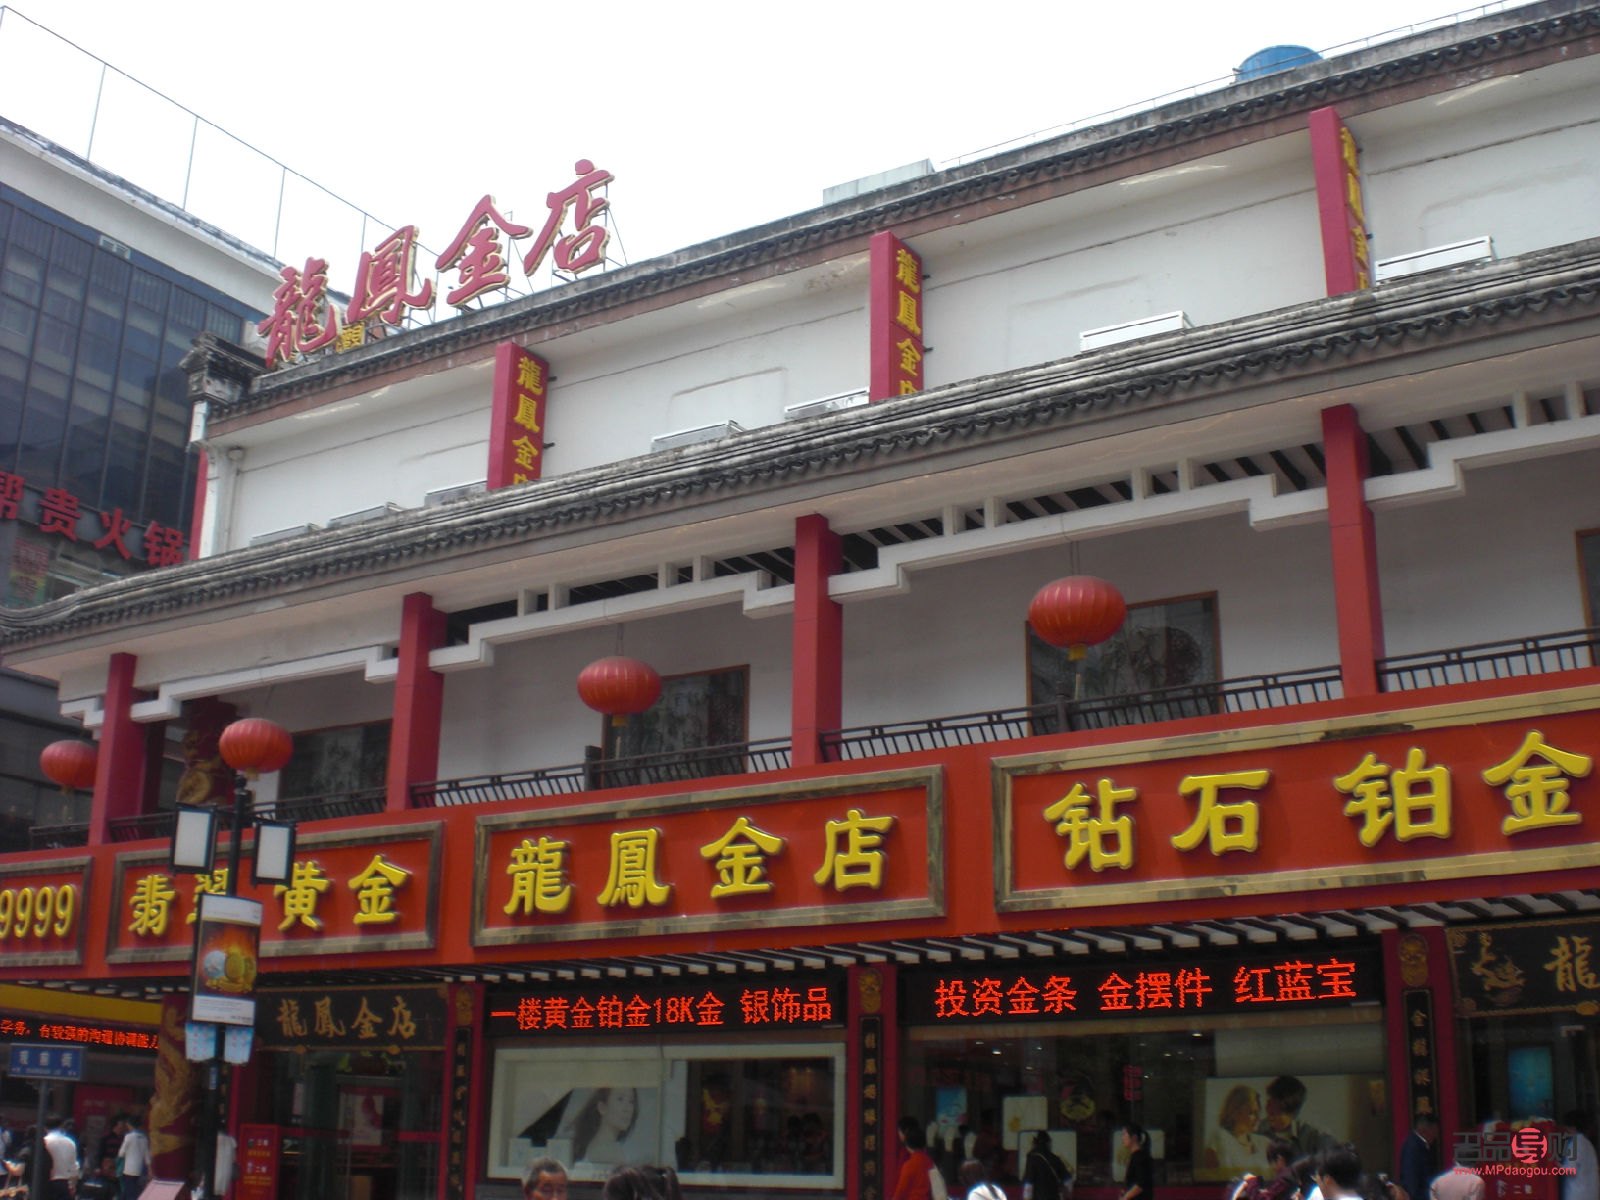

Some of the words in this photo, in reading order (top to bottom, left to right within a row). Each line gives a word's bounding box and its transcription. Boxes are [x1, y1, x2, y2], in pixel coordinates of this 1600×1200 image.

[257, 159, 615, 364] 龍鳳金店
[504, 808, 895, 915] 龍鳳金店
[935, 975, 1078, 1018] 投资金条
[1097, 967, 1213, 1011] 金摆件
[1233, 957, 1357, 1003] 红蓝宝
[1543, 935, 1600, 991] 龍
[276, 995, 417, 1039] 龍鳳金店
[490, 989, 726, 1031] 一楼黄金铂金18K金
[739, 986, 832, 1024] 银饰品
